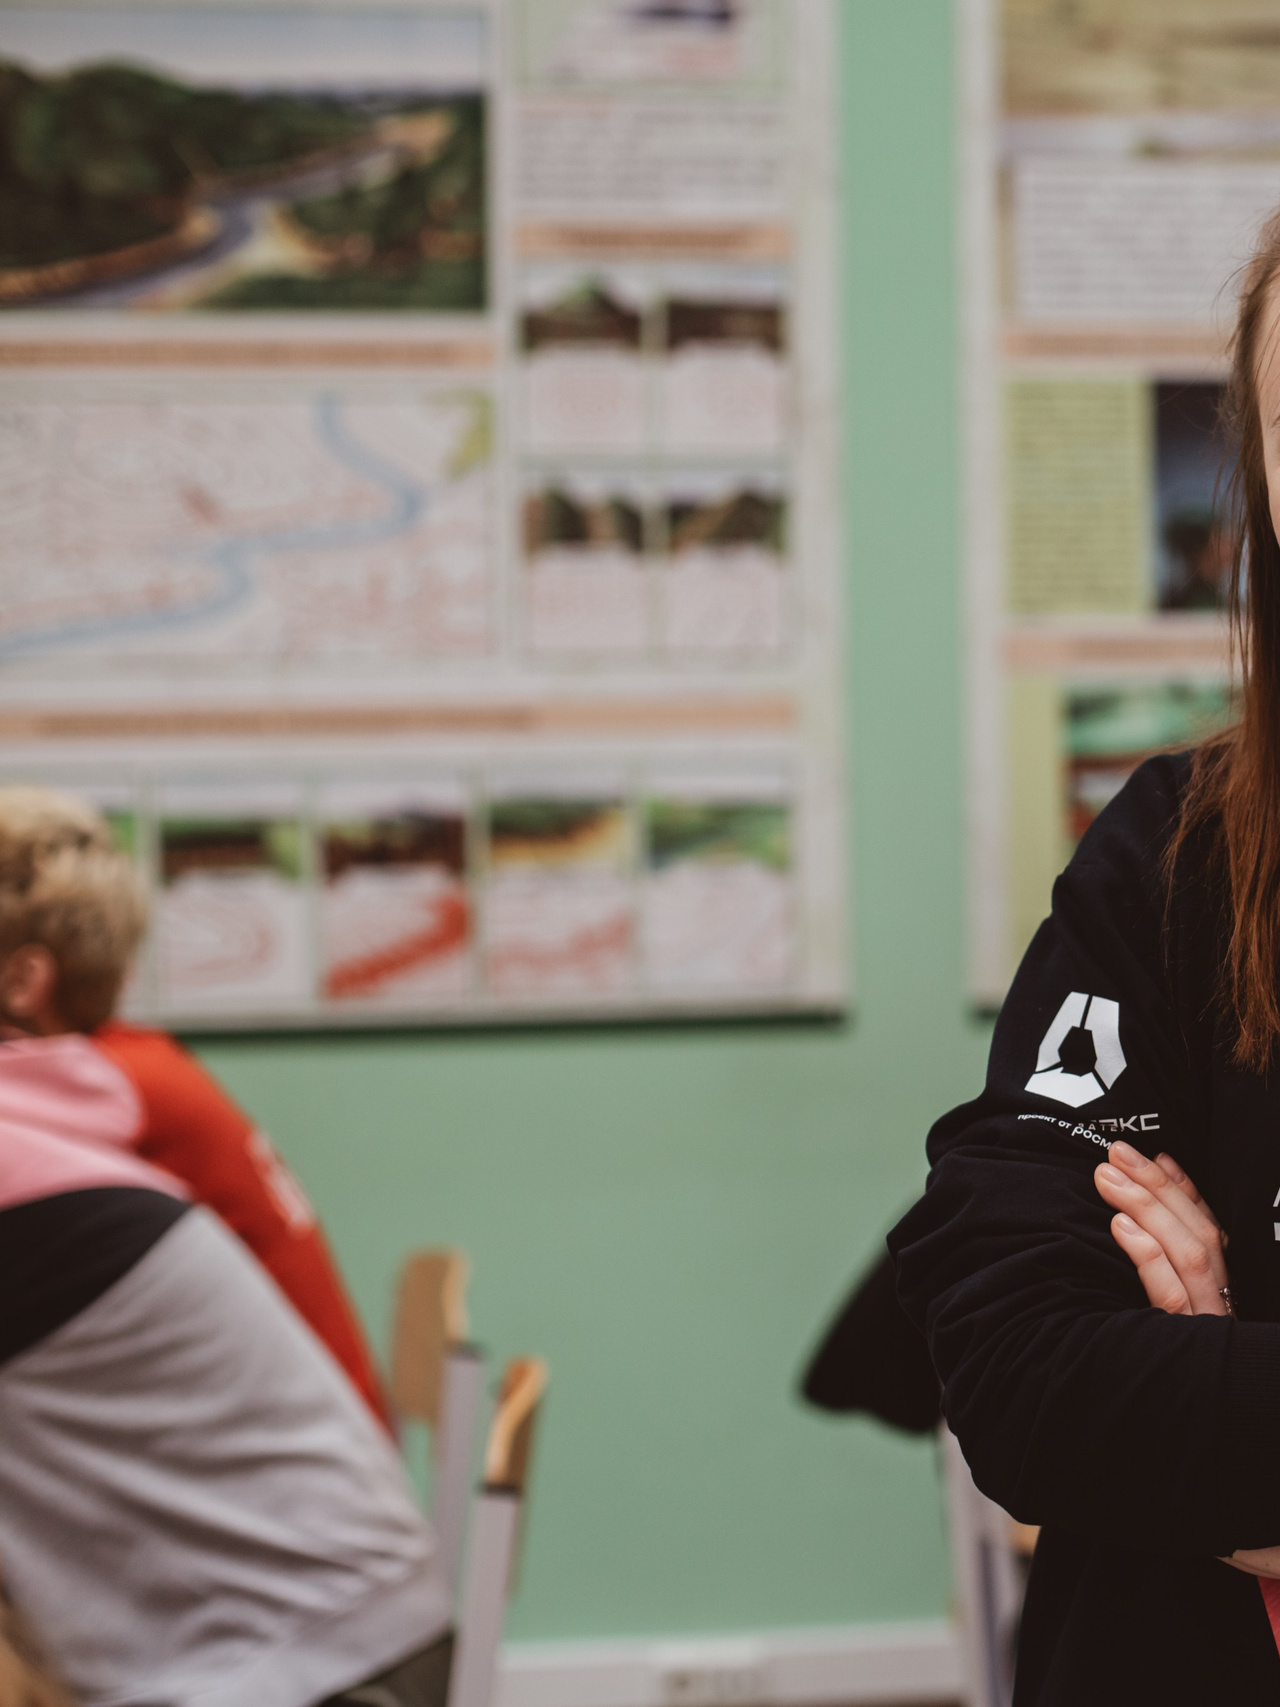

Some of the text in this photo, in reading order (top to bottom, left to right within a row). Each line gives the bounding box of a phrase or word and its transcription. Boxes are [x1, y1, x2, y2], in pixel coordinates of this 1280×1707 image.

[1017, 1114, 1112, 1150] проект от росм
